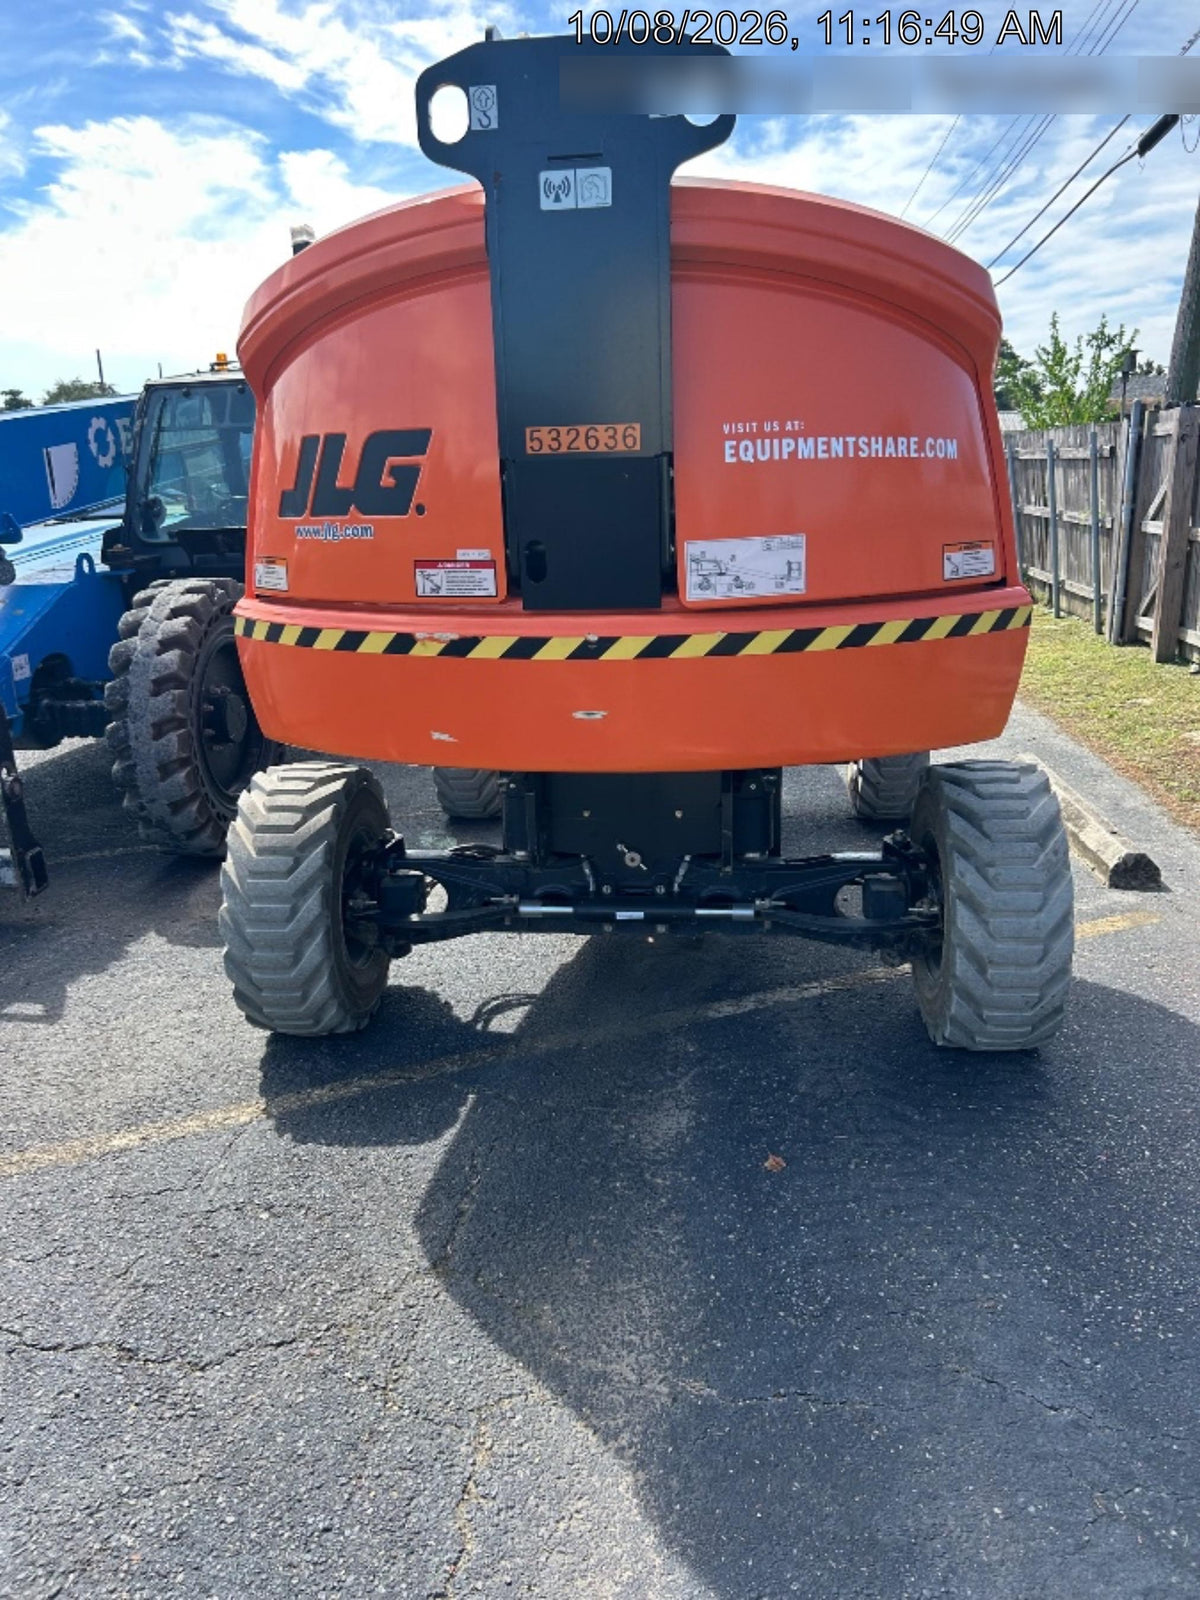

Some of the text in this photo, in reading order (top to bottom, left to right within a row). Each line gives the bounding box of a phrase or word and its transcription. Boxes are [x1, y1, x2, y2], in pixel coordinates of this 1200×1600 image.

[723, 420, 804, 434] VISIT US AT:
[529, 426, 637, 452] 532636
[724, 436, 957, 463] EQUIPMENTSHARE.COM
[296, 522, 373, 541] www.jlg.com
